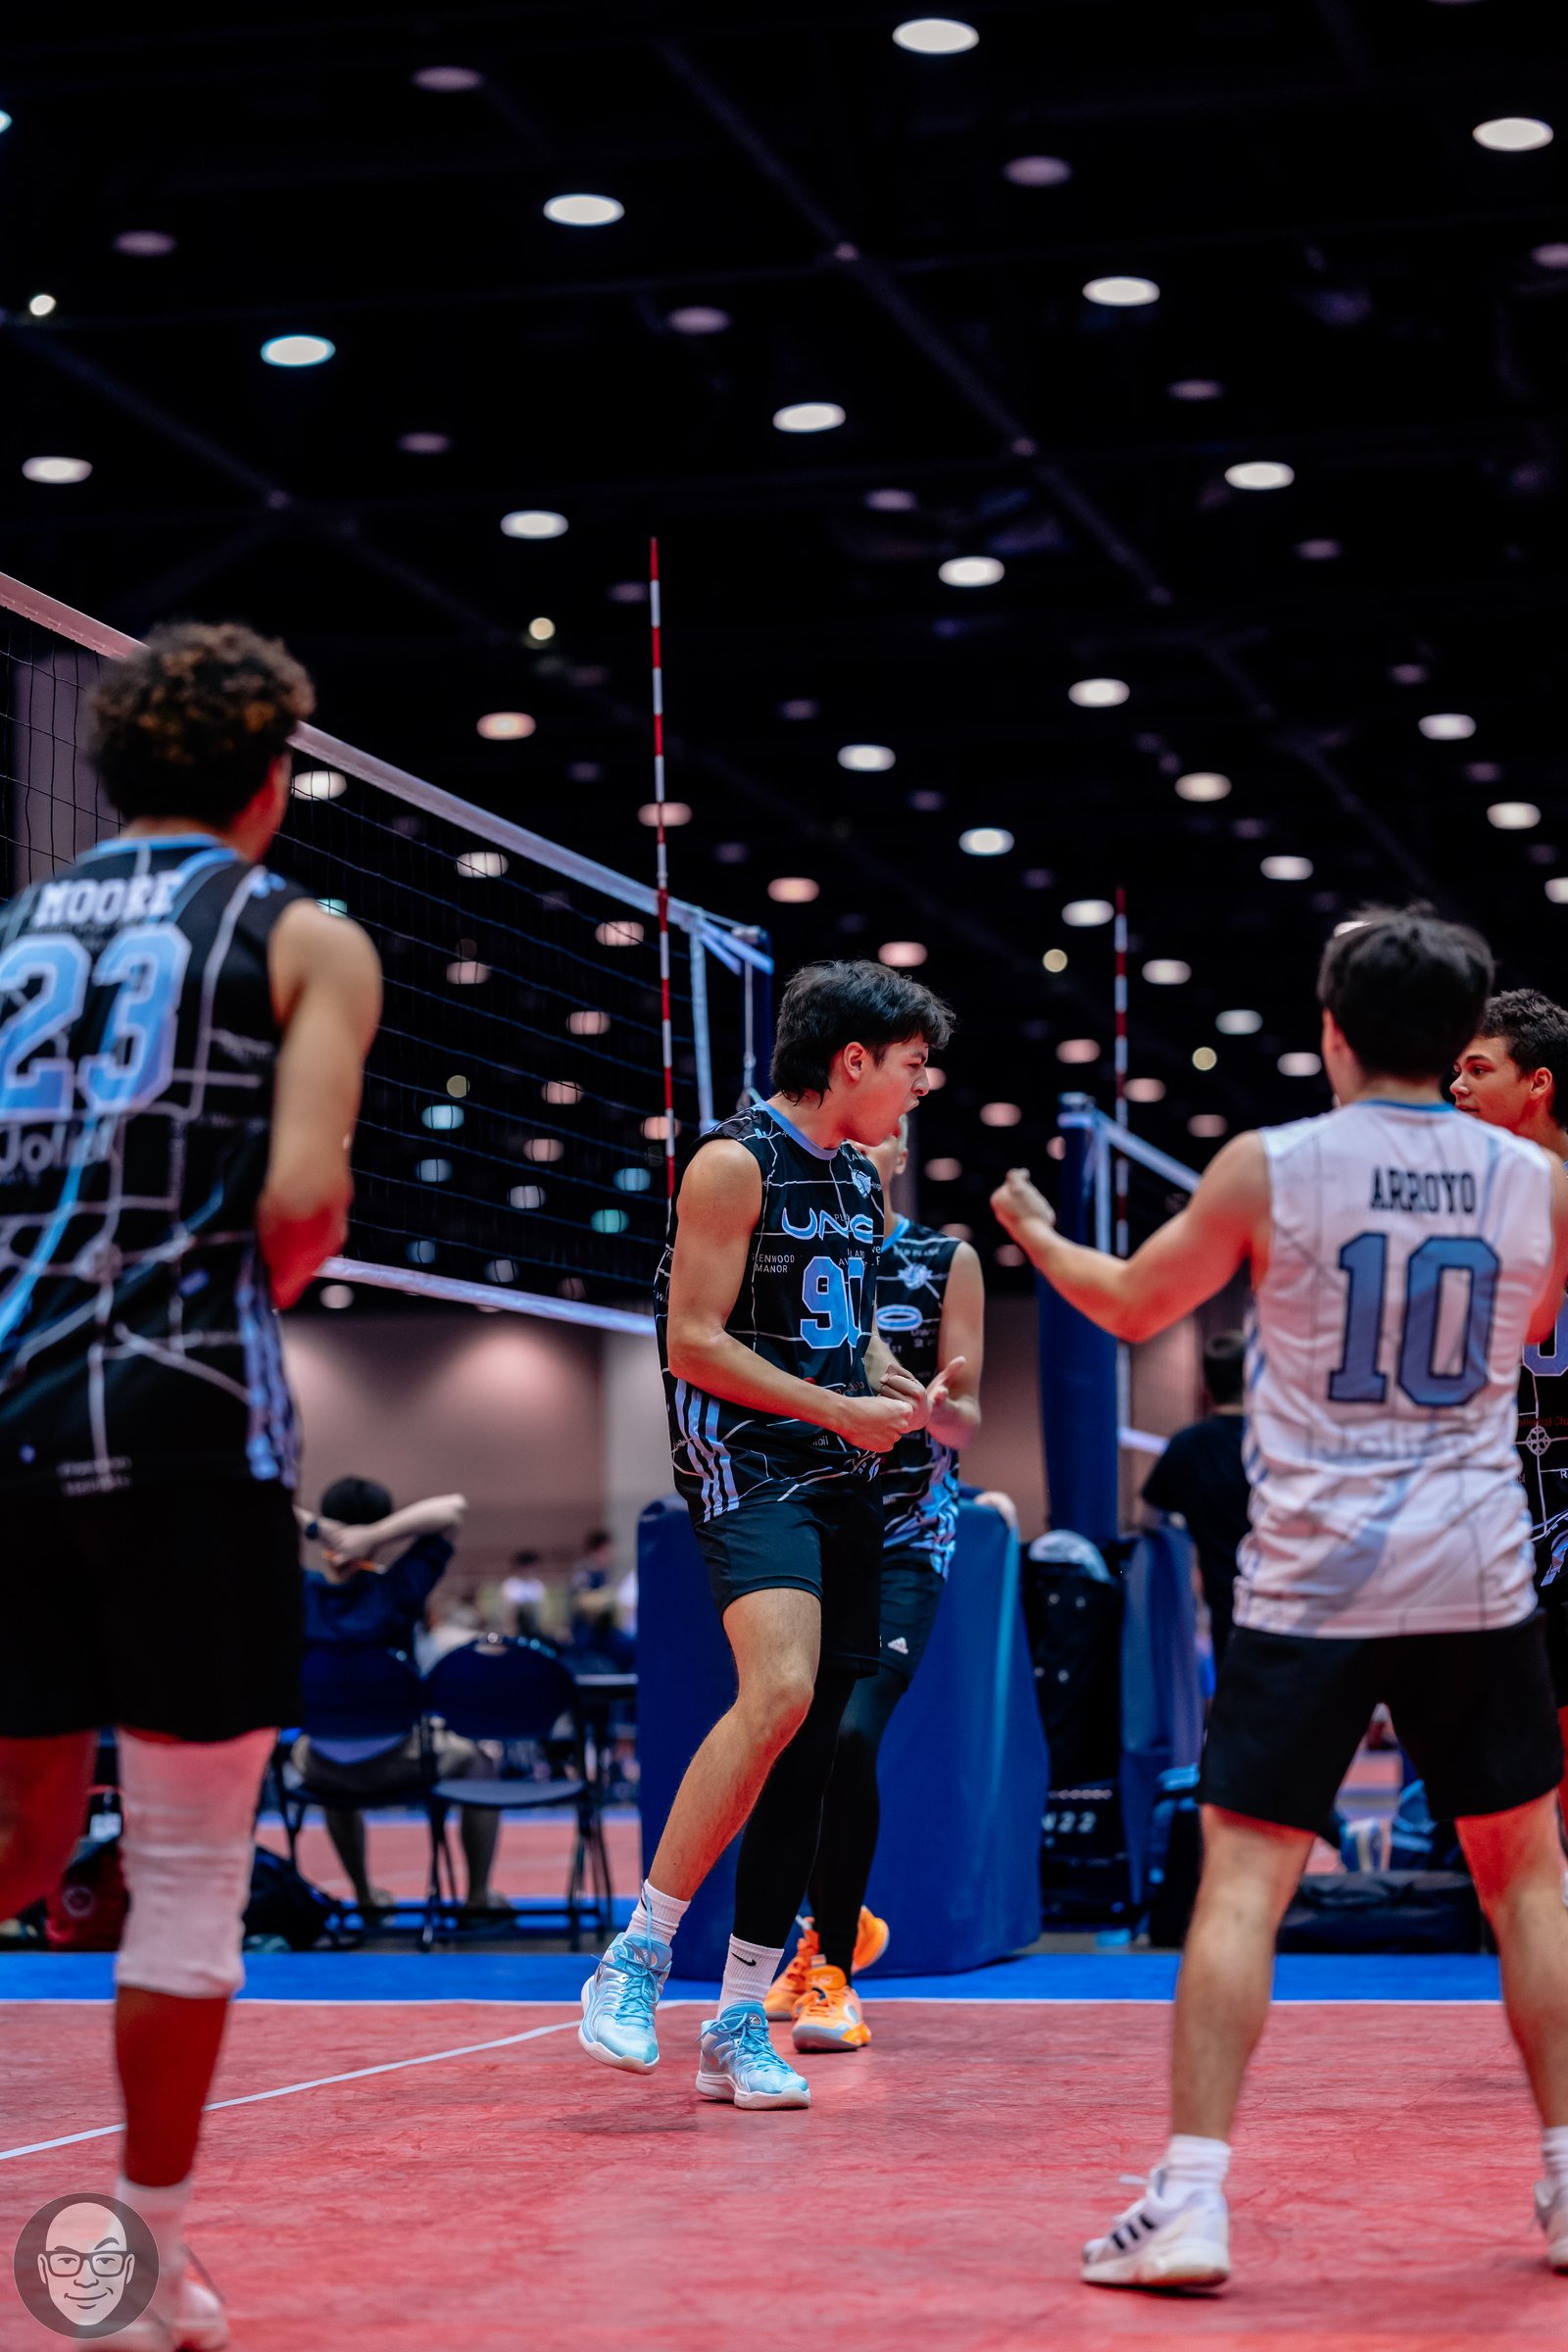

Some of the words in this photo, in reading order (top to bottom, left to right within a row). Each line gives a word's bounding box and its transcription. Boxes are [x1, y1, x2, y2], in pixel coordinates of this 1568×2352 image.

[33, 871, 183, 928] MOORE
[0, 923, 191, 1124] 23
[1370, 1166, 1475, 1214] ARROYO
[755, 1263, 788, 1273] MANOR
[1328, 1232, 1500, 1406] 10
